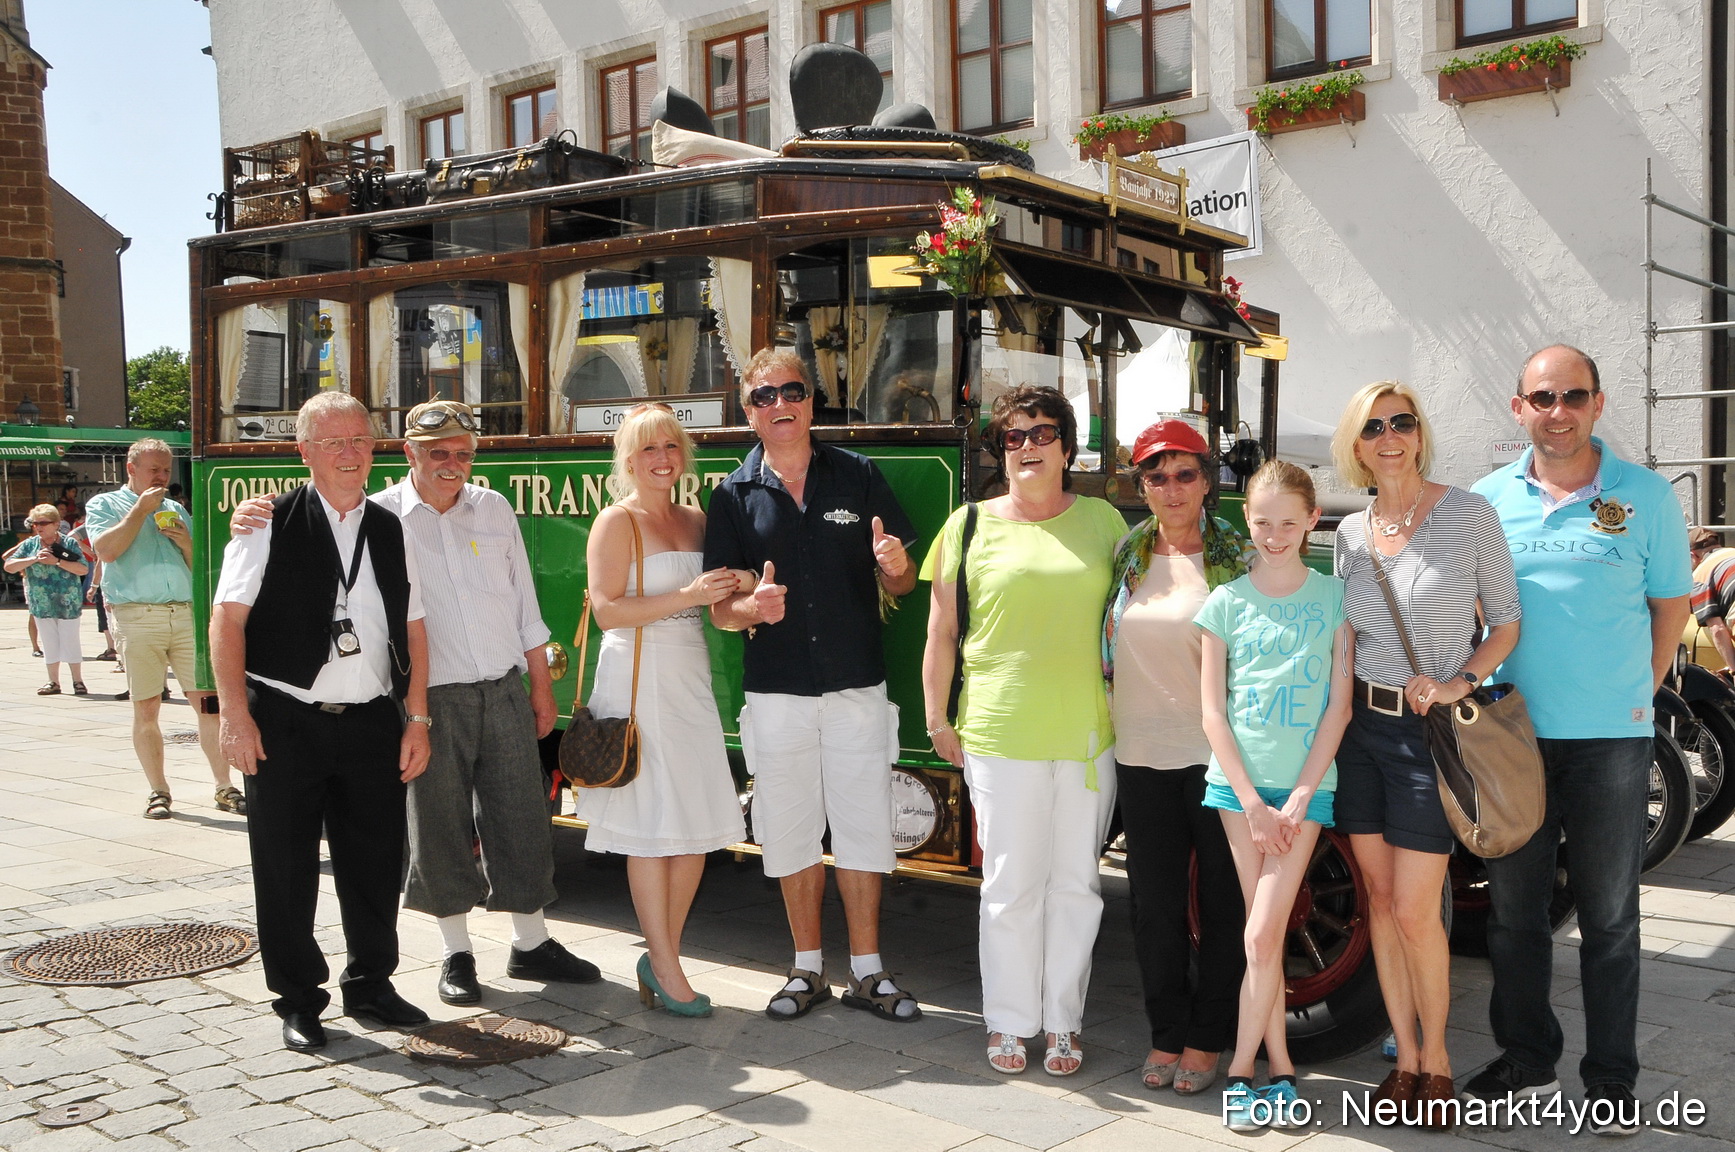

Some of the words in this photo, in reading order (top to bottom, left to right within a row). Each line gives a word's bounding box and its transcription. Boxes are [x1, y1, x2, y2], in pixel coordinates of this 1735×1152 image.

[1119, 176, 1152, 200] Baujahr
[1154, 188, 1176, 206] 1923
[1186, 190, 1247, 218] ation
[278, 419, 298, 434] Clas
[1508, 540, 1624, 561] ORSICA
[1234, 618, 1326, 663] GOOD
[1287, 655, 1323, 684] TO
